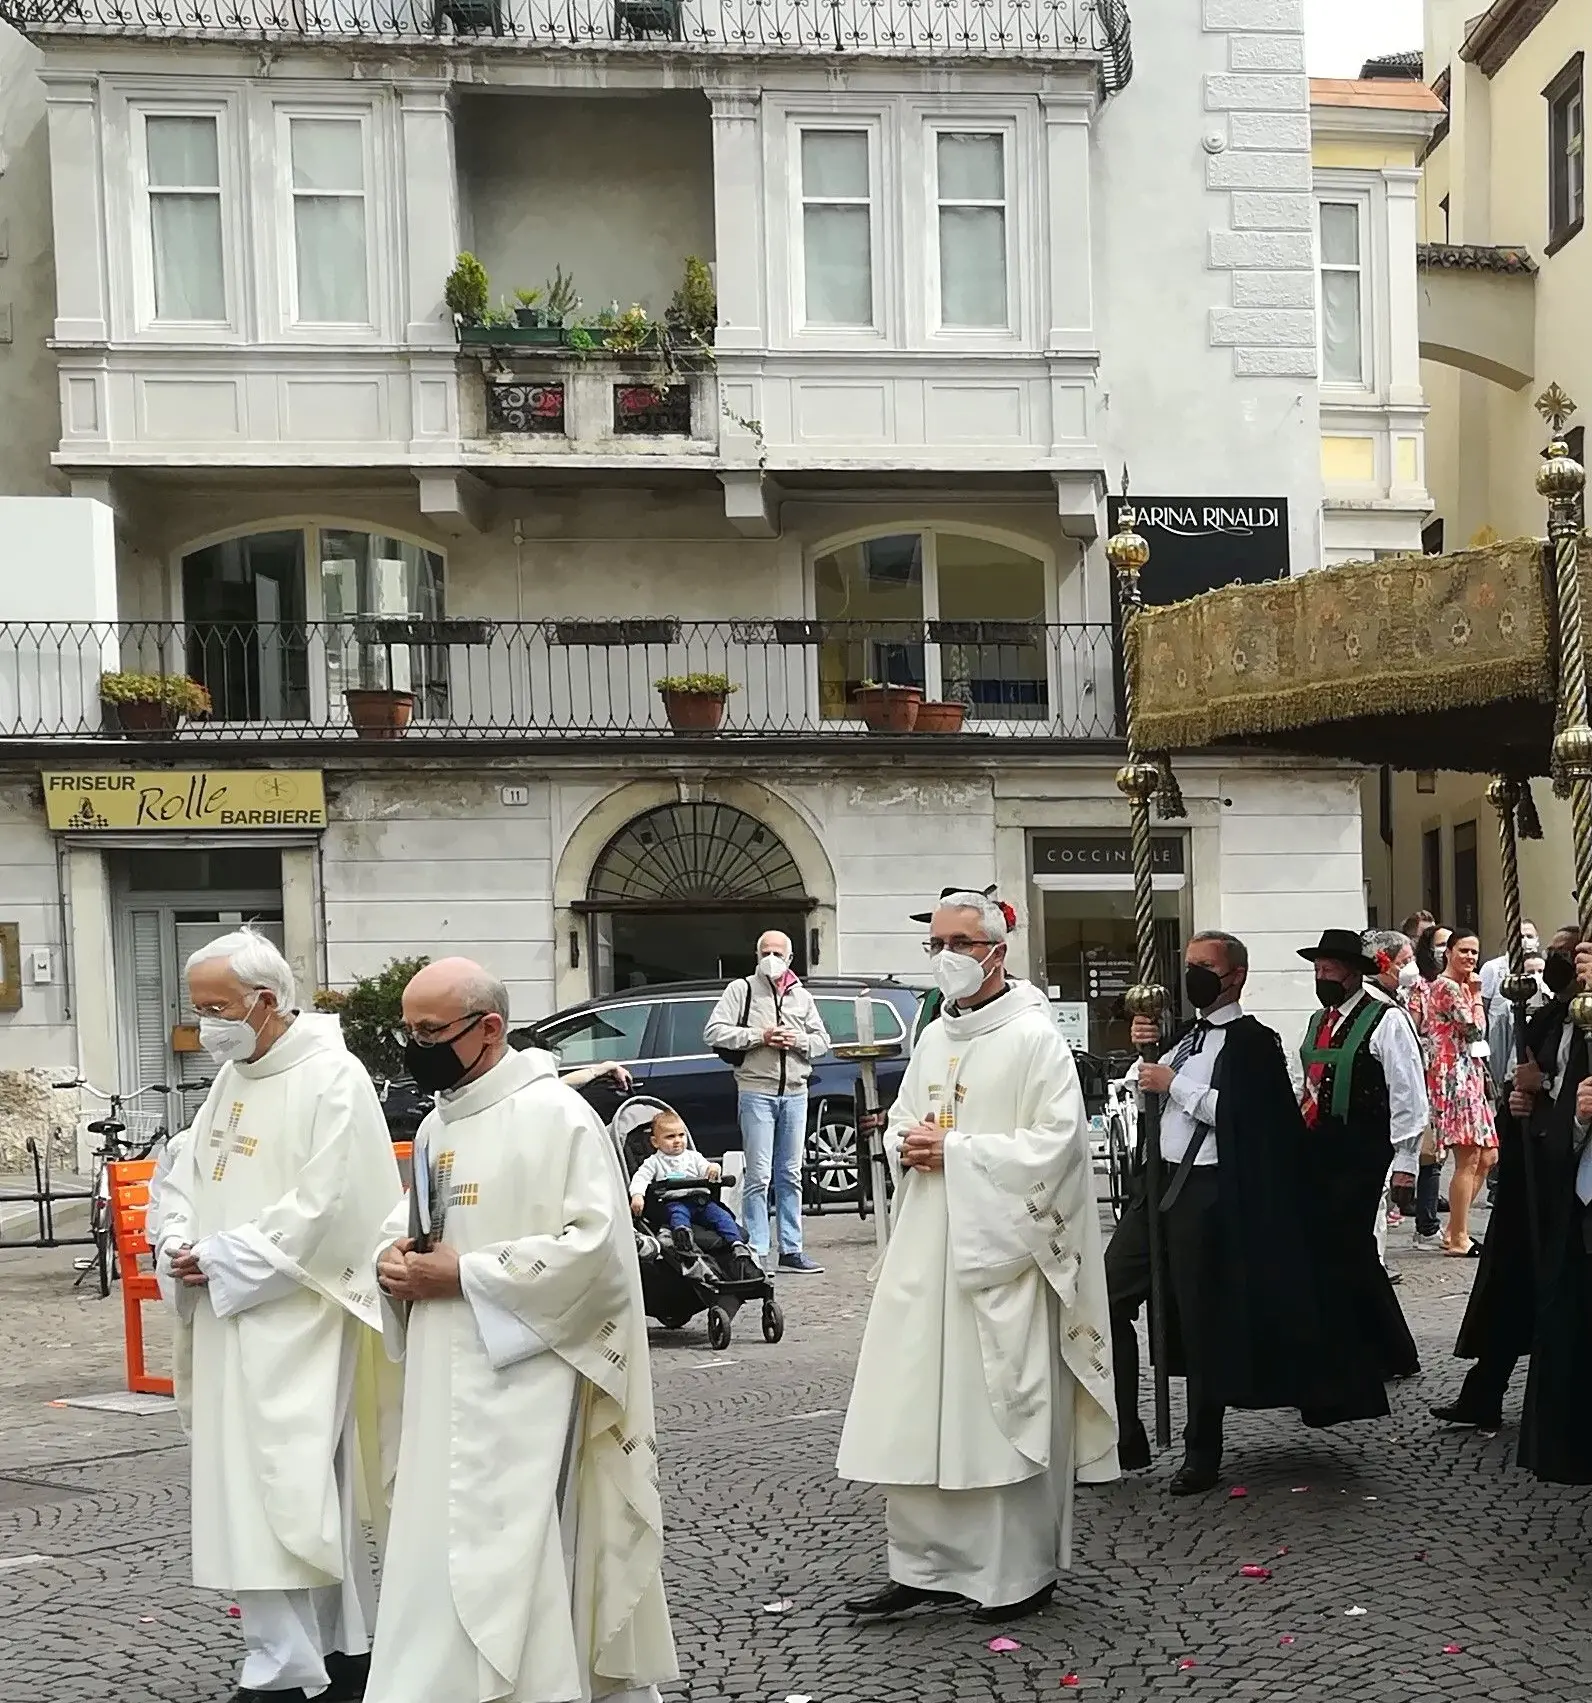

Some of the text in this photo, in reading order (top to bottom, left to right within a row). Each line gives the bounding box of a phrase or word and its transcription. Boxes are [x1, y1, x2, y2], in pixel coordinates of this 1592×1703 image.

[1203, 507, 1279, 531] RINALDI
[49, 776, 135, 791] FRISEUR
[136, 774, 228, 825] Rolle
[510, 791, 520, 801] 11
[221, 810, 322, 824] BARBIERE
[1047, 850, 1170, 862] COCCINLE
